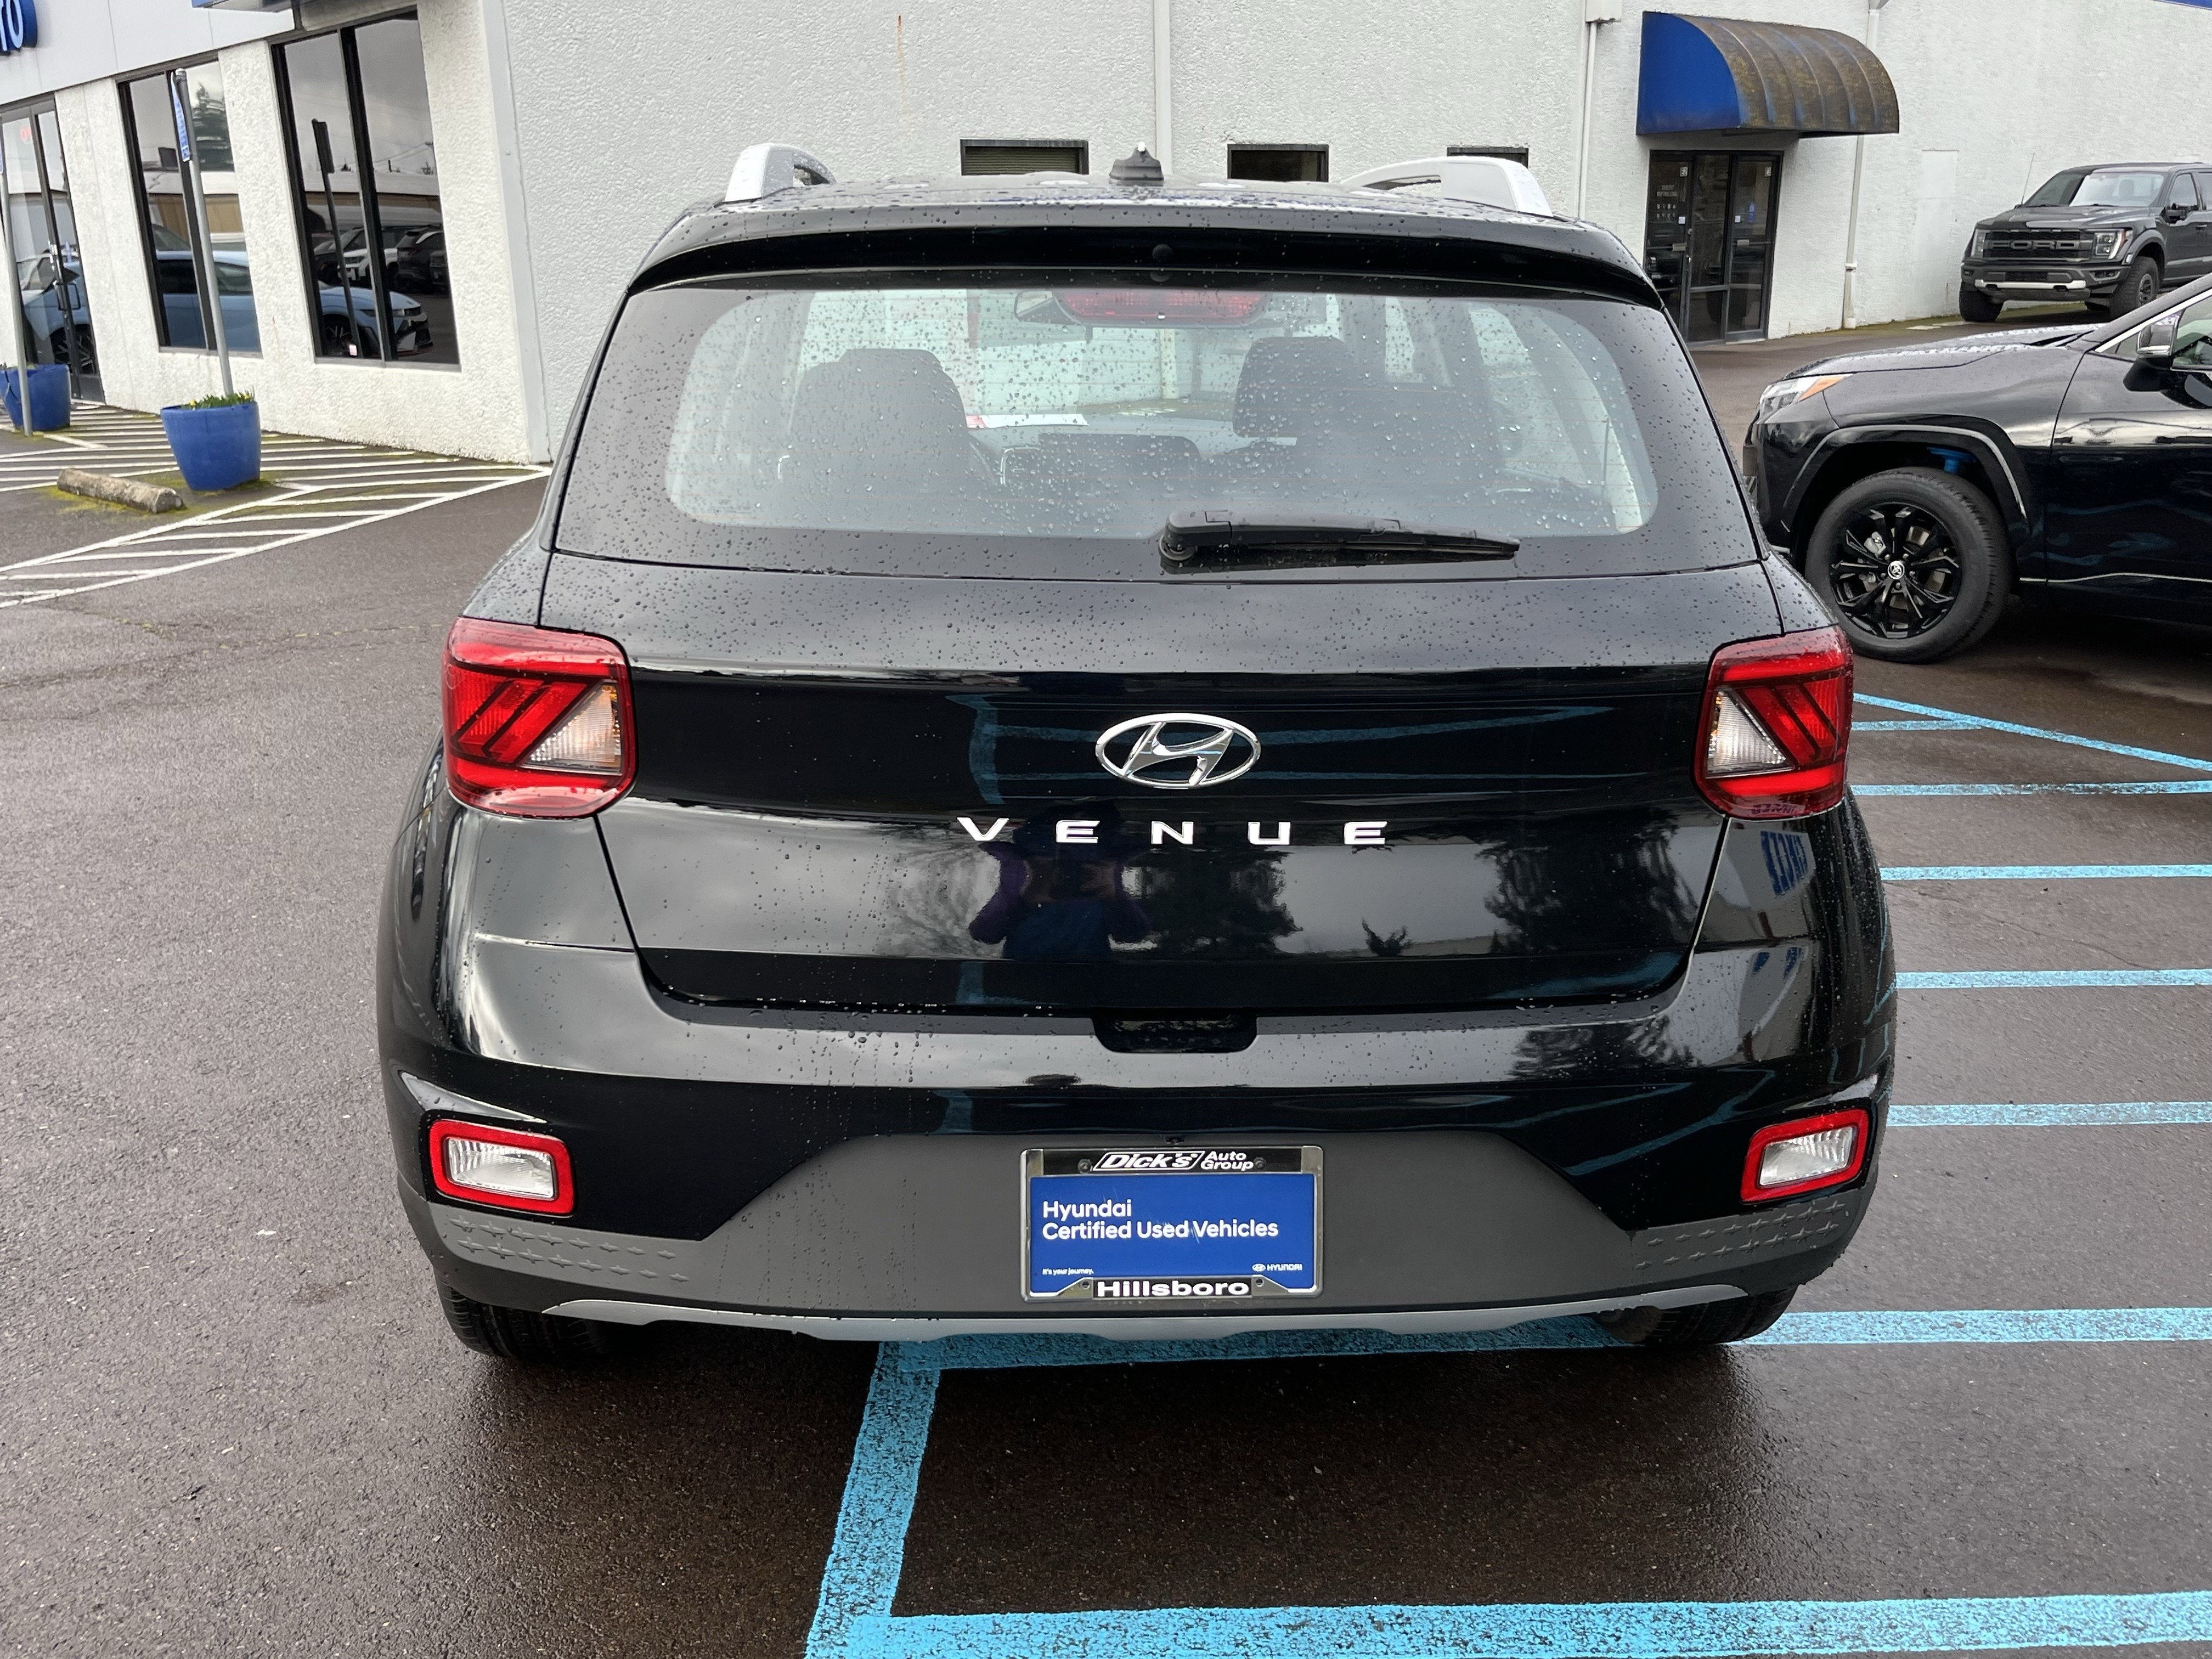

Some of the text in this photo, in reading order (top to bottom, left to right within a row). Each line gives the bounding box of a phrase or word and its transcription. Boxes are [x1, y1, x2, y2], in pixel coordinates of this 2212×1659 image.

[1989, 240, 2079, 250] FORD
[957, 817, 1388, 845] VENUE
[1206, 1151, 1246, 1161] Auto
[1200, 1160, 1254, 1171] Group
[1042, 1199, 1132, 1221] Hyundai
[1042, 1219, 1279, 1239] Certified Used Vehicles
[1097, 1280, 1249, 1297] Hillsboro
